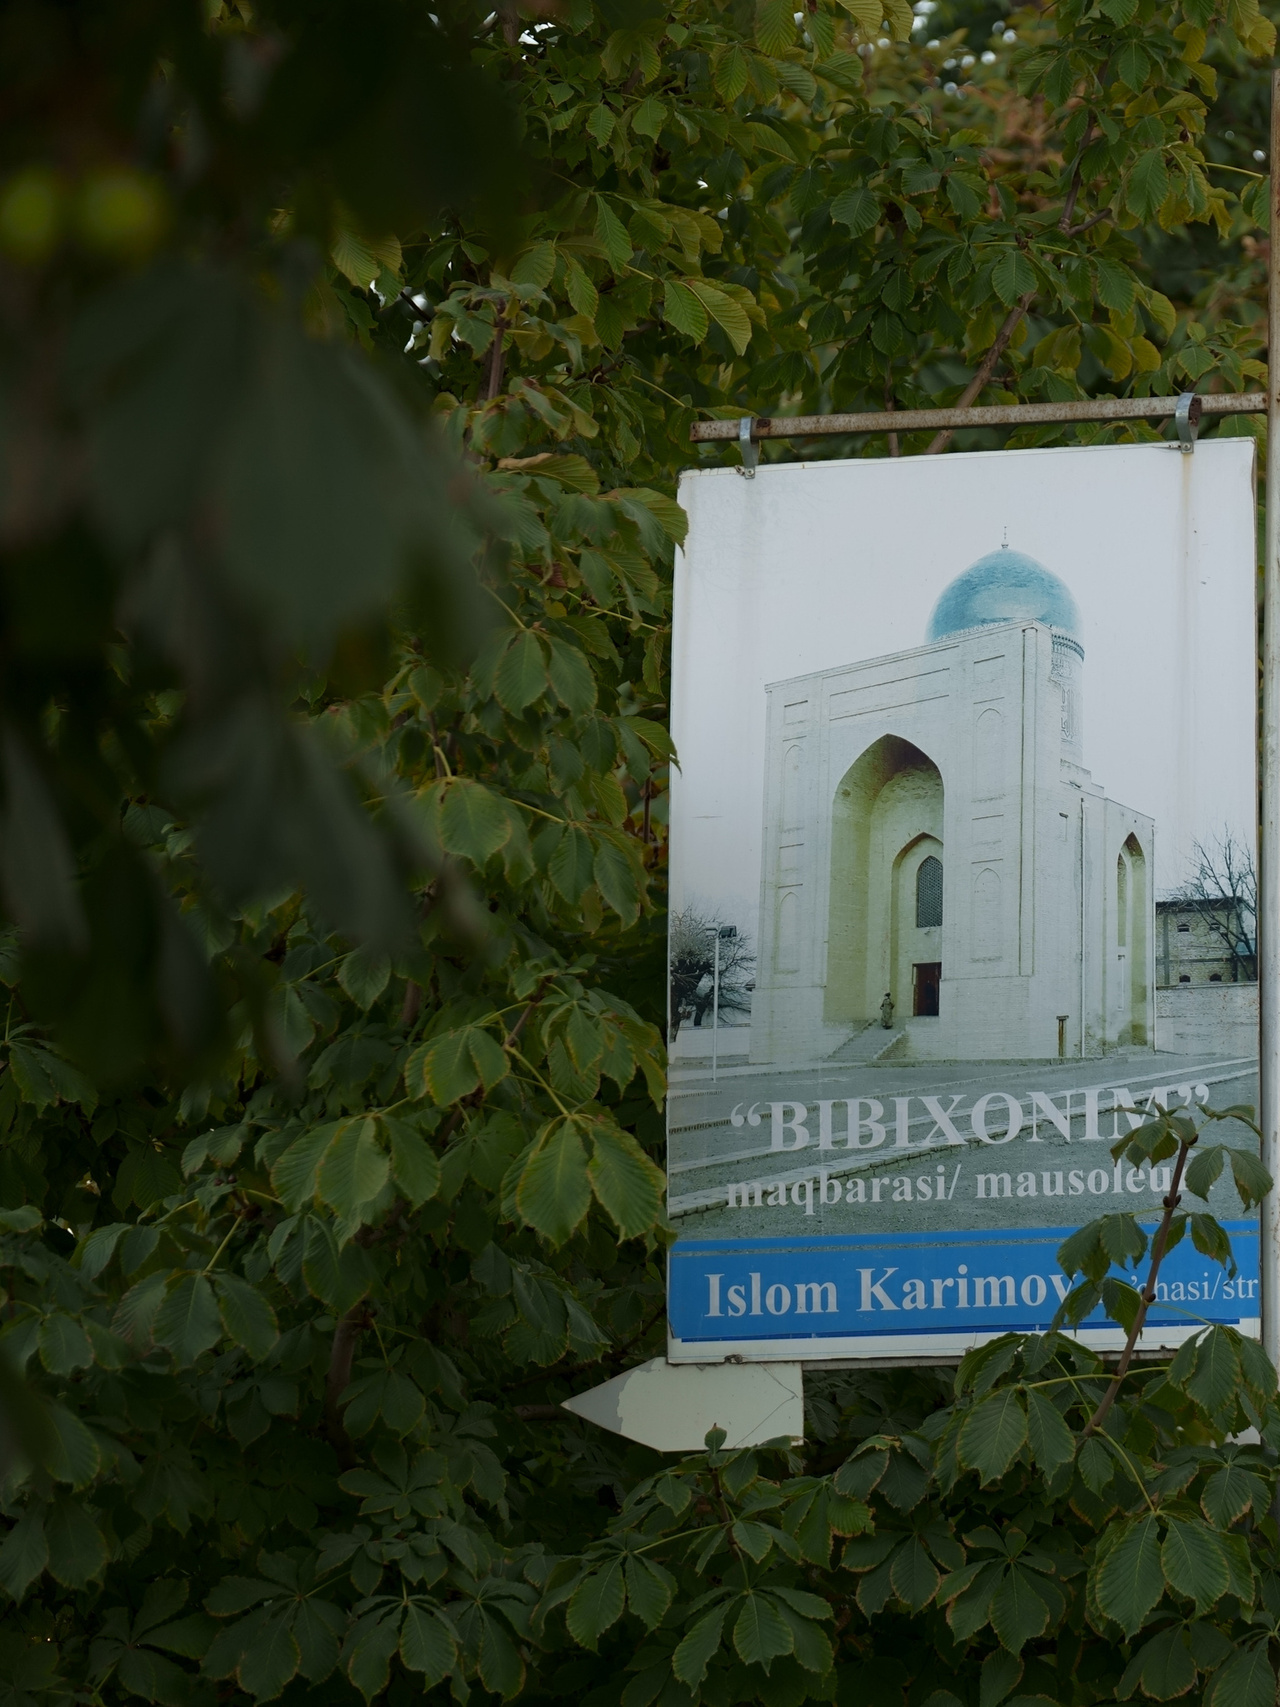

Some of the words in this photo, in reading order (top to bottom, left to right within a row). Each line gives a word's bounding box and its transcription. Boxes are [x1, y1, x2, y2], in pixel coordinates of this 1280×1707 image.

[727, 1163, 962, 1216] maqbarasi/
[704, 1271, 839, 1318] Islom
[856, 1264, 1077, 1311] Karimov
